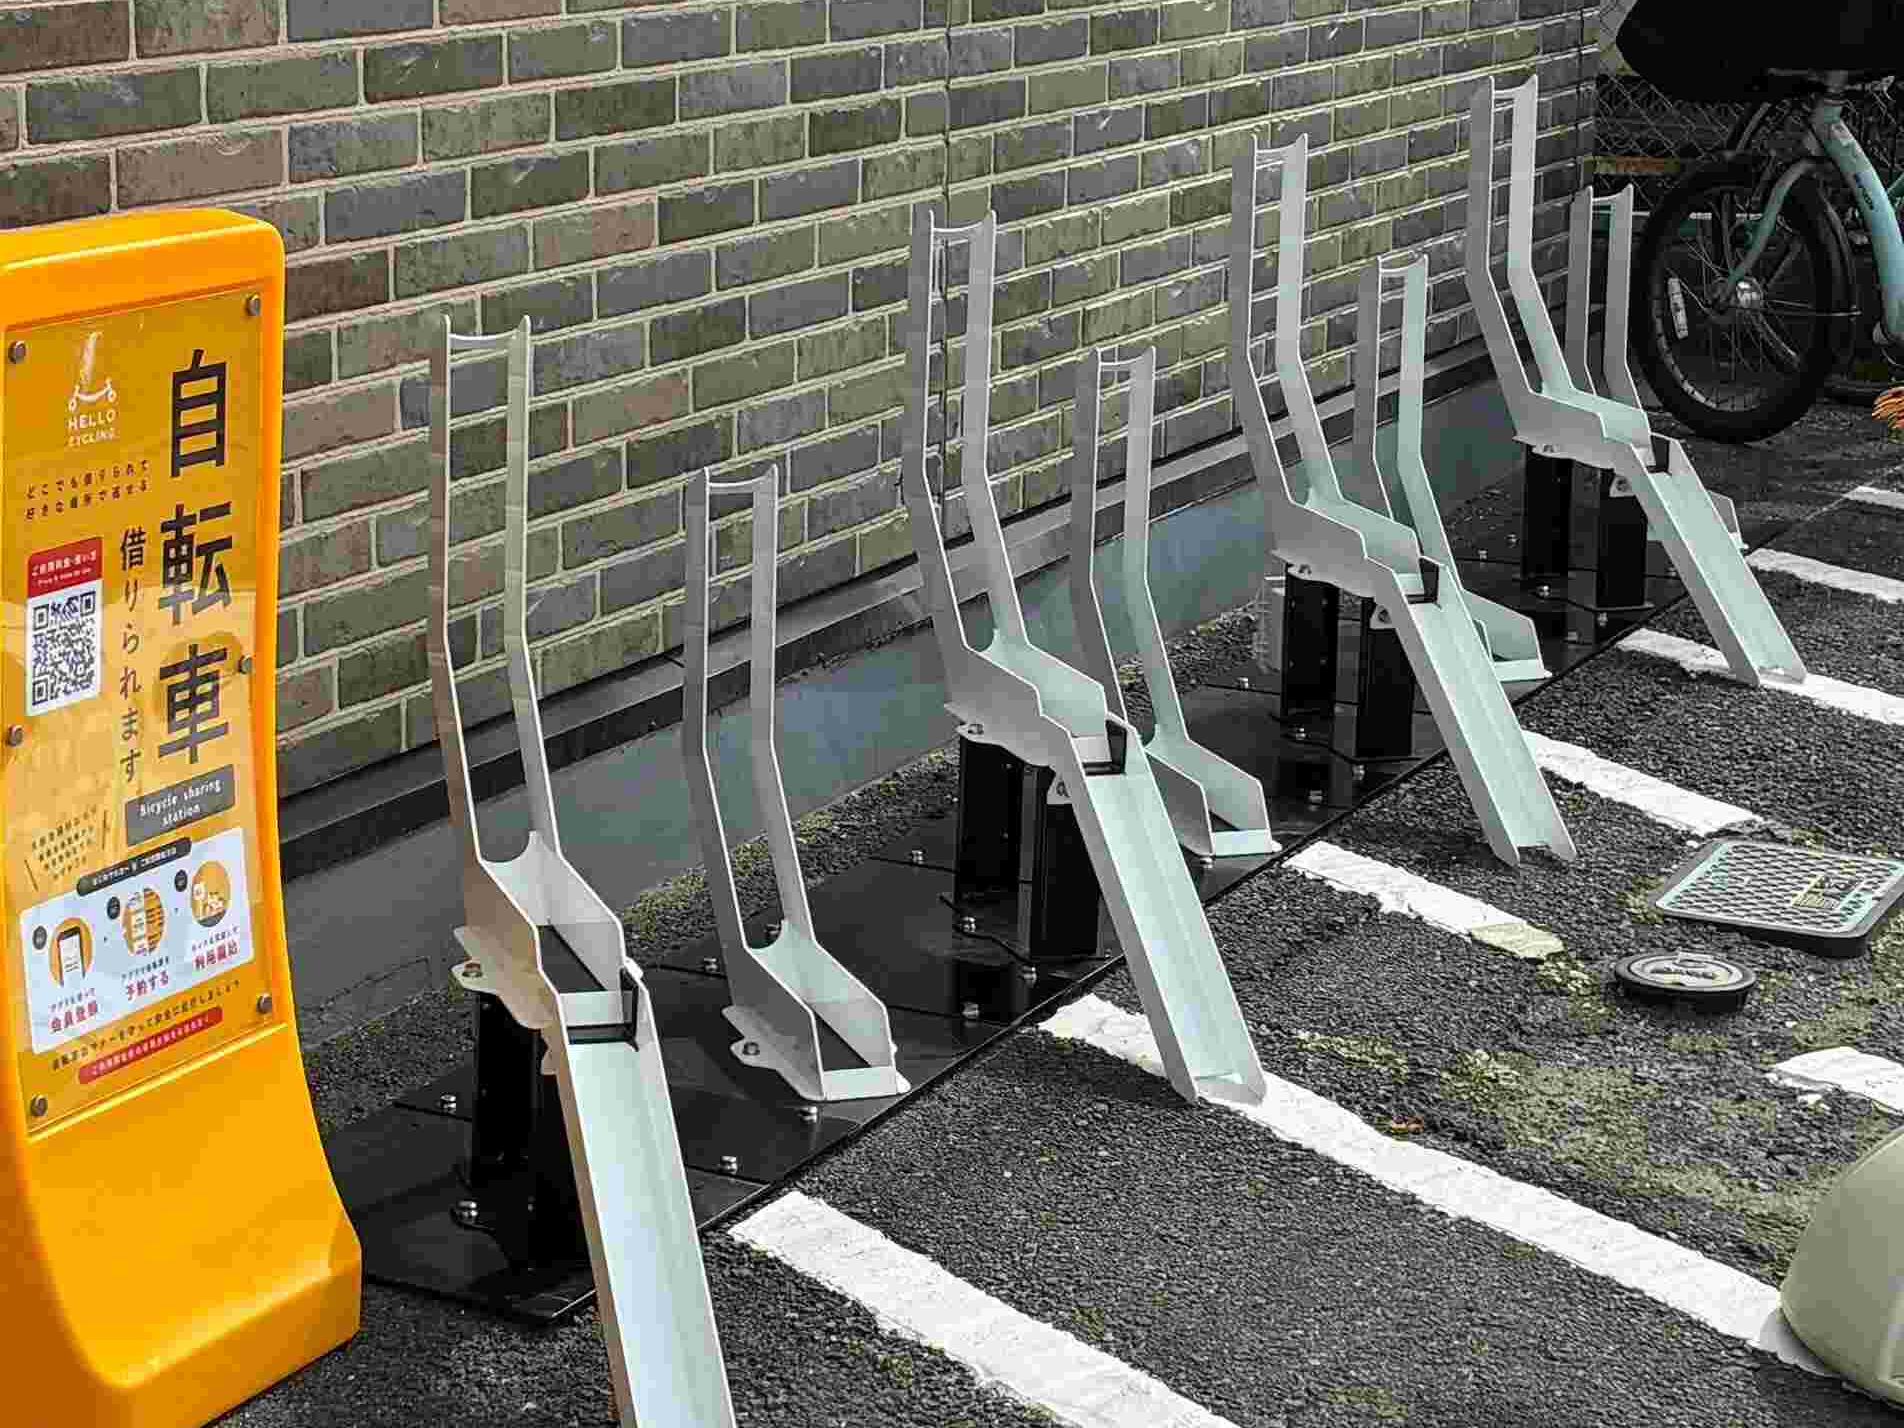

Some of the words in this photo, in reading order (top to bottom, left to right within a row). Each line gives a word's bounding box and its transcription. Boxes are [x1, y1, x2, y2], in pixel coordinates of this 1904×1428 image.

[67, 409, 116, 430] HELLO
[158, 348, 234, 764] 自転車
[119, 526, 147, 784] 借りられます
[140, 794, 178, 818] Bicycle
[183, 778, 222, 802] sharing
[162, 803, 201, 827] station
